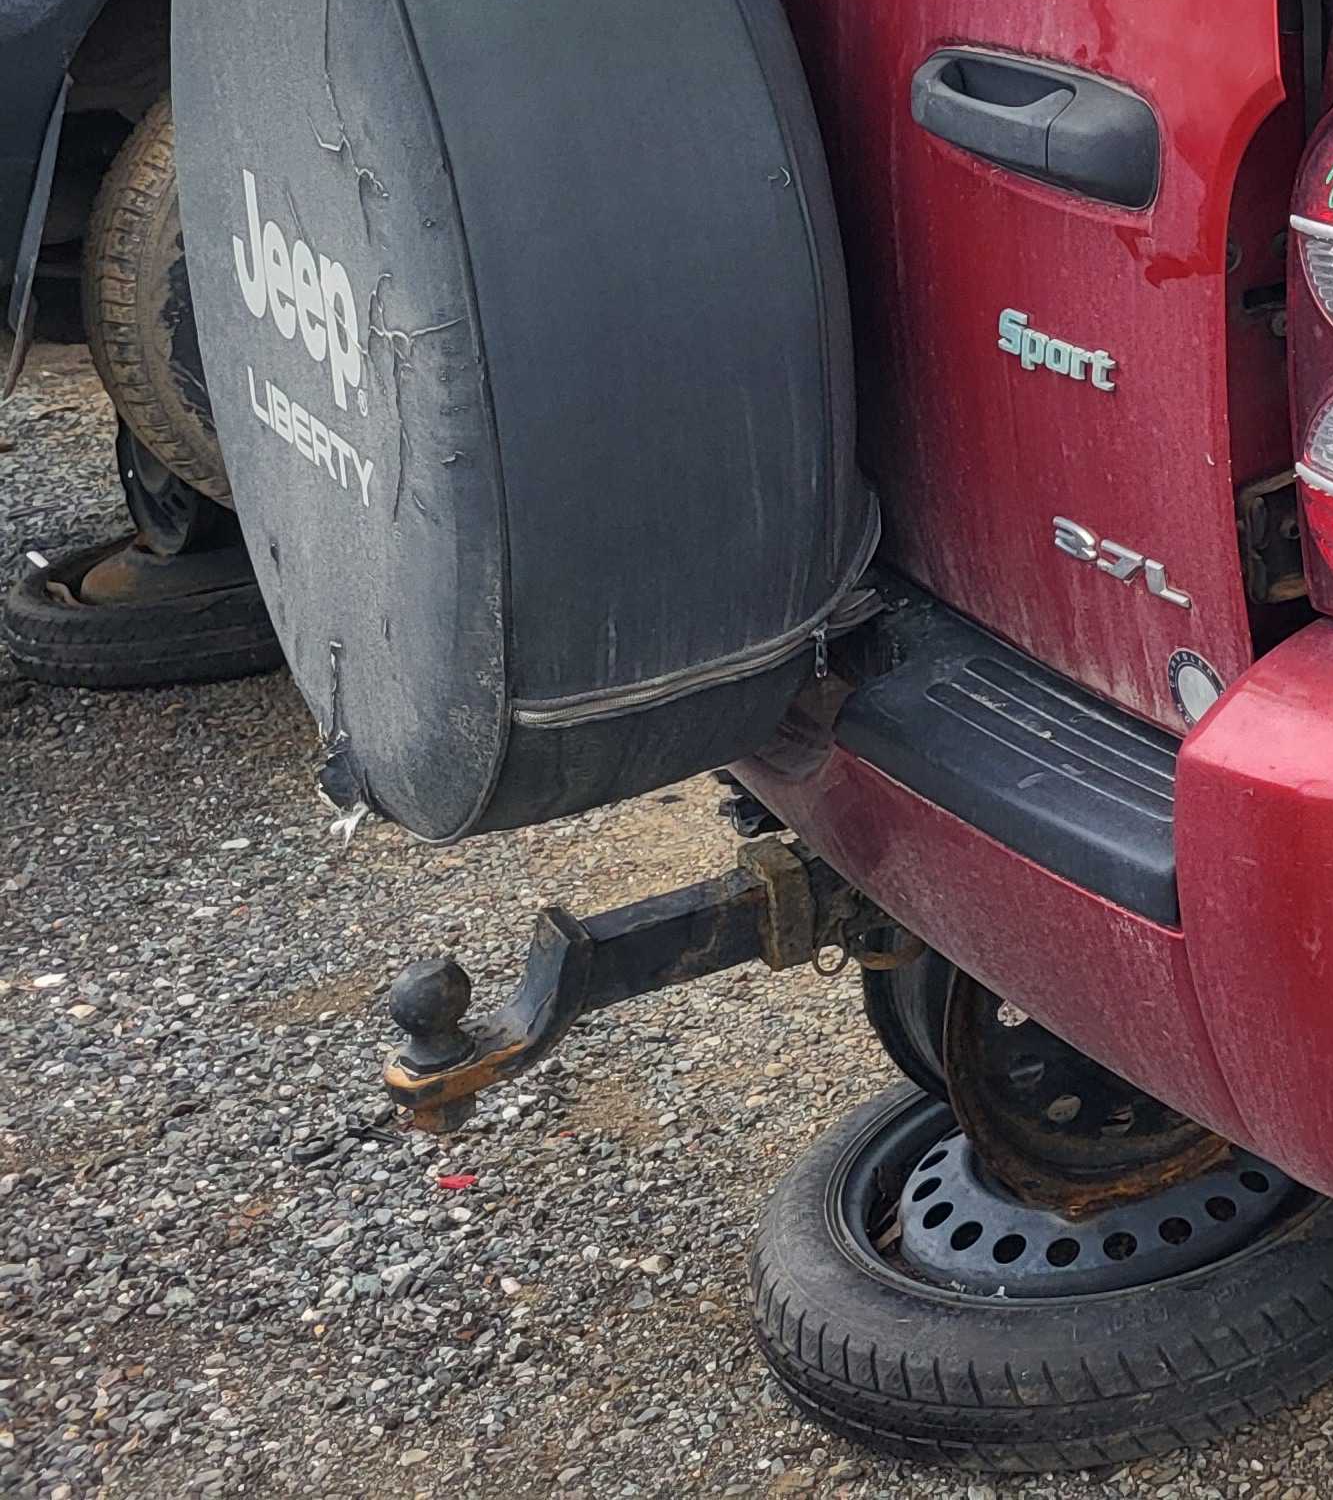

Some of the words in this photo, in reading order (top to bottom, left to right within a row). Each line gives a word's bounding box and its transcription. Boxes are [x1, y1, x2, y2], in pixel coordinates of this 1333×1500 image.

[232, 168, 361, 412] Jeep
[997, 307, 1117, 392] Sport
[246, 365, 375, 508] LIBERTY
